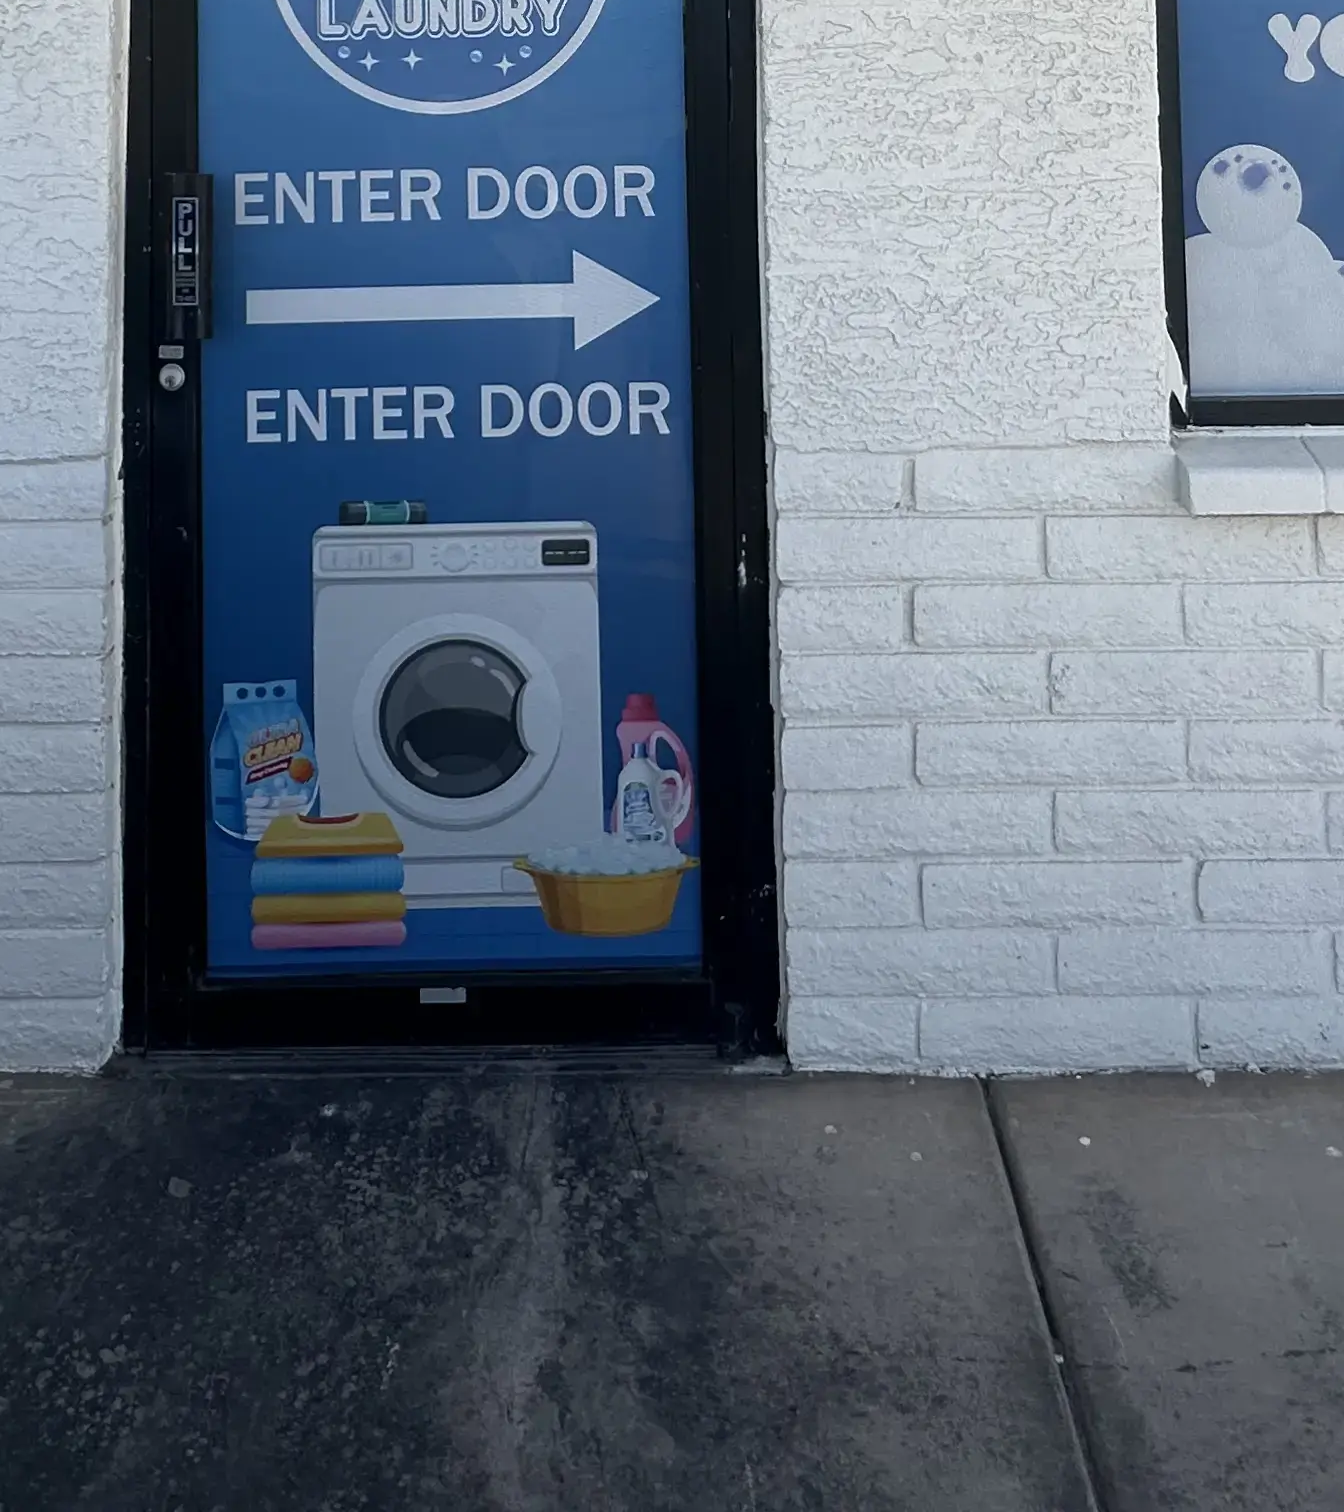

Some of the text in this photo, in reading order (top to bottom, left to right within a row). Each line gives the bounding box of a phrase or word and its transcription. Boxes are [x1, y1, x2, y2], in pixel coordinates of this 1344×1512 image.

[234, 165, 655, 226] ENTER DOOR
[178, 203, 193, 271] PULL
[246, 382, 670, 443] ENTER DOOR
